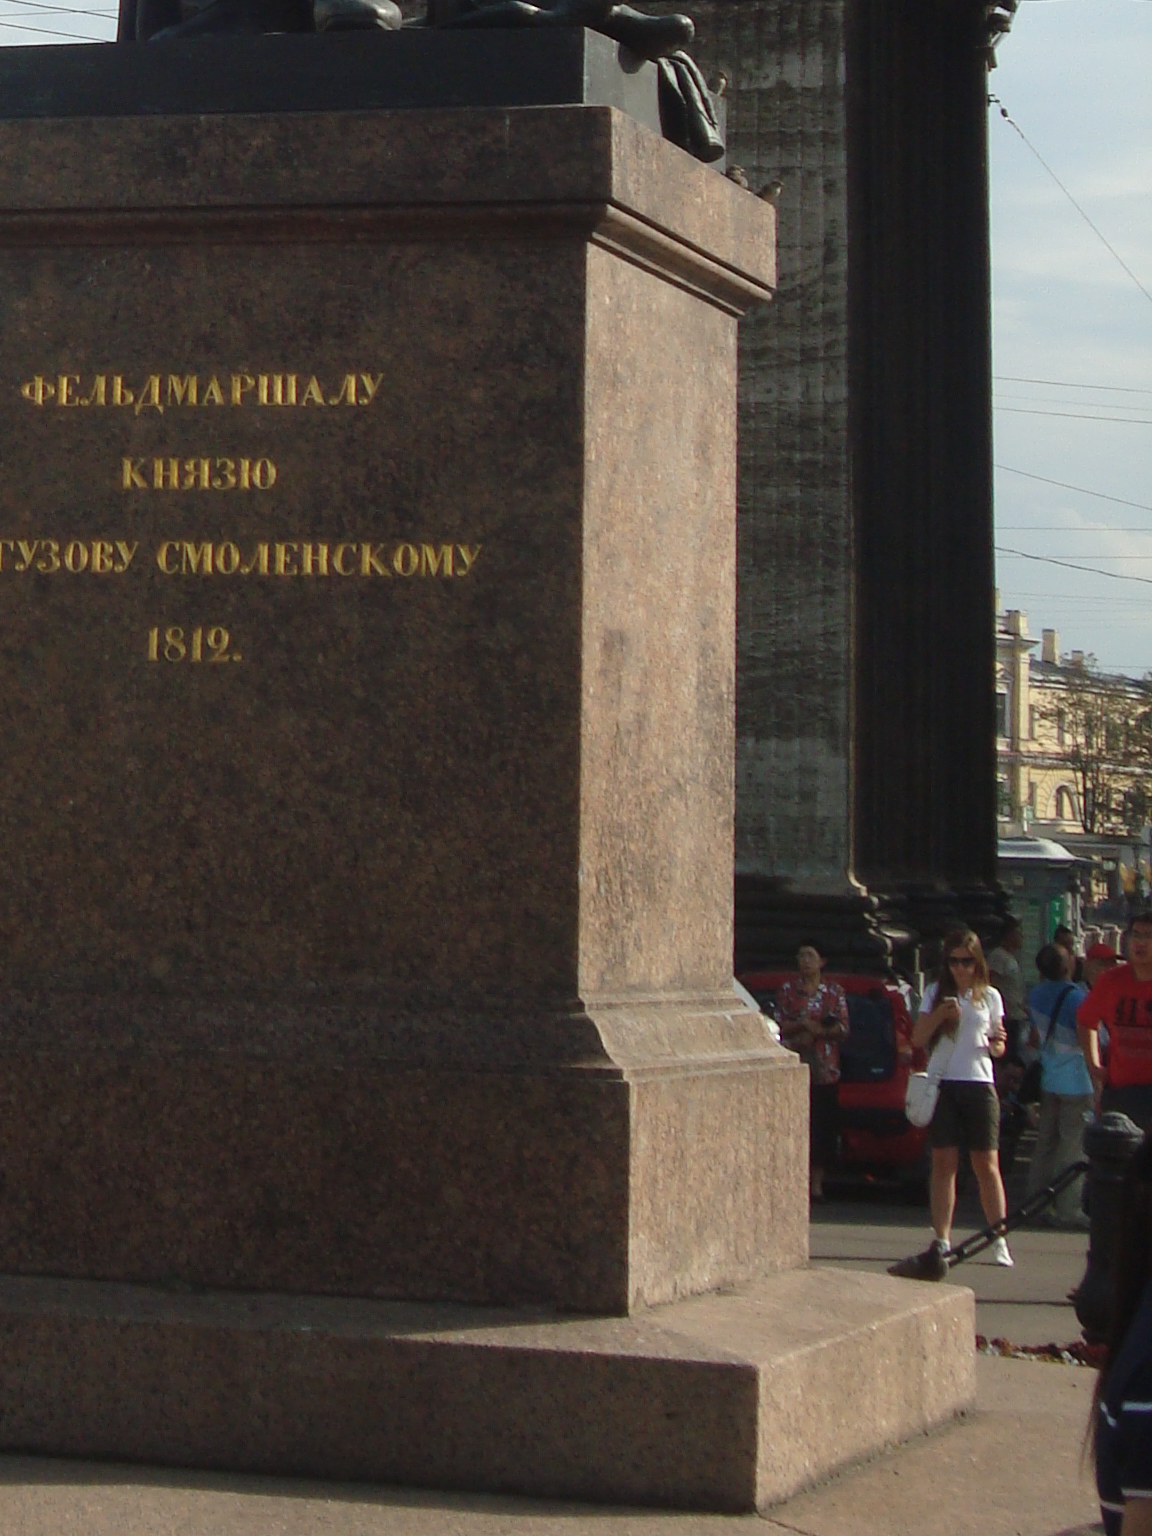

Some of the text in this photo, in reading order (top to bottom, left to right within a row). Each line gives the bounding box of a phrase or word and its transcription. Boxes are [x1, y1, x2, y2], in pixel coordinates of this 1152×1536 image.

[21, 372, 385, 416] ФЕЛЬДМАРШАЛУ
[120, 455, 278, 491] КНЯЗЮ
[156, 539, 483, 578] СМОЛЕНСКОМУ
